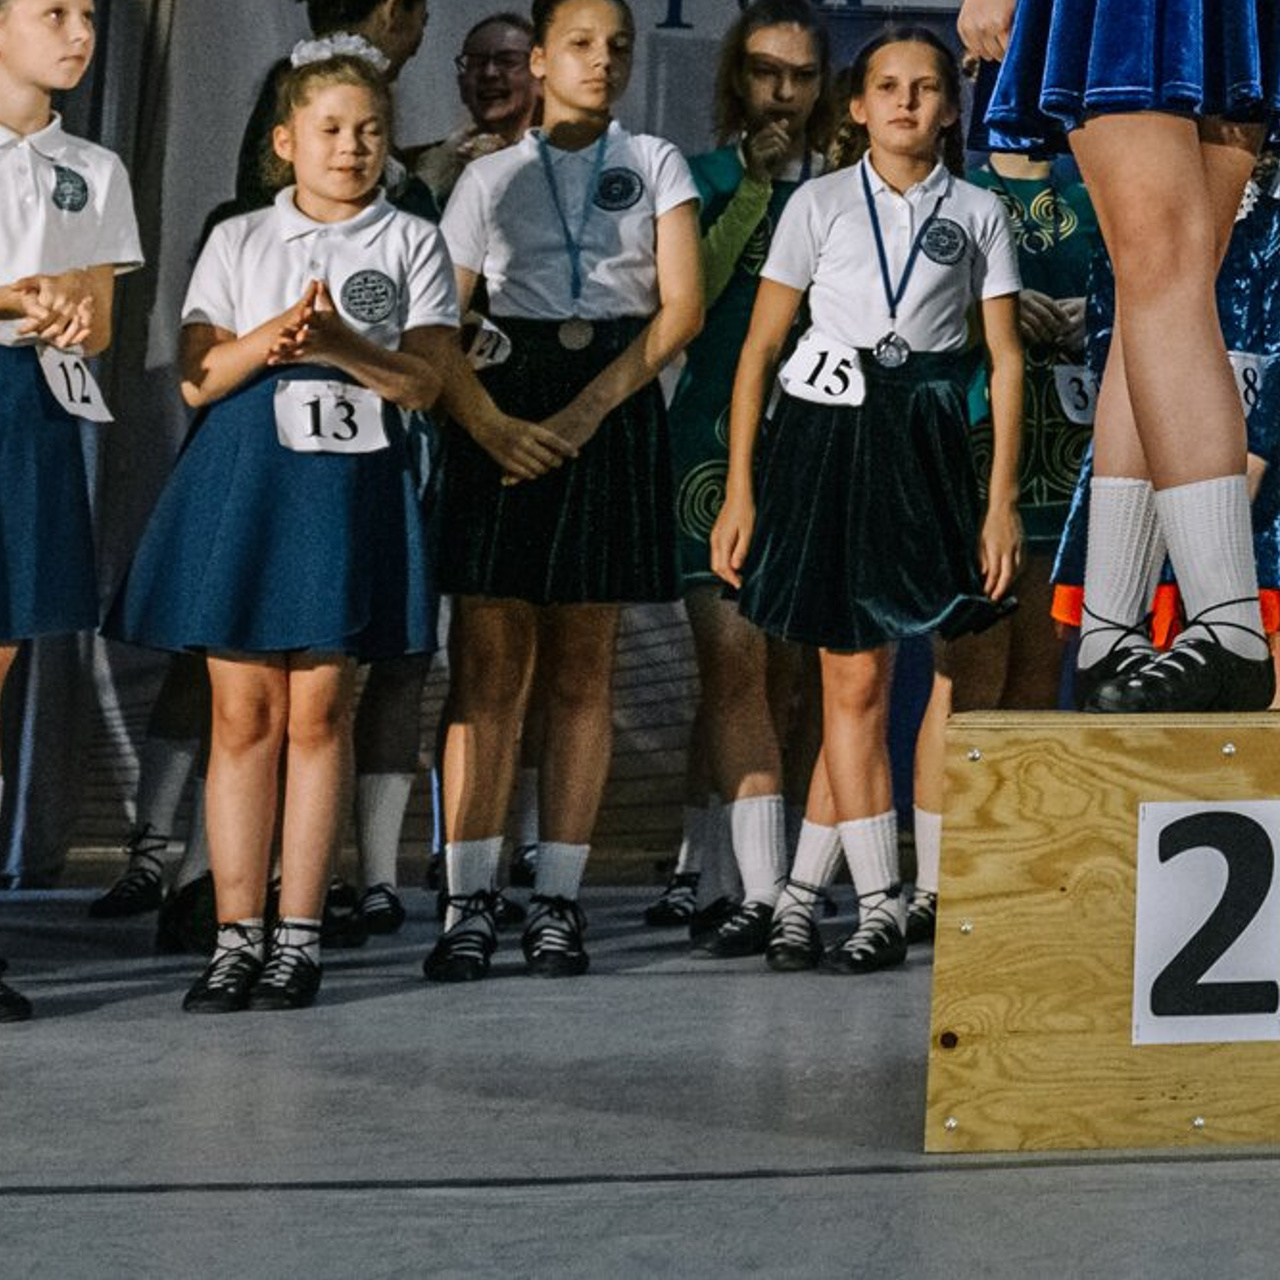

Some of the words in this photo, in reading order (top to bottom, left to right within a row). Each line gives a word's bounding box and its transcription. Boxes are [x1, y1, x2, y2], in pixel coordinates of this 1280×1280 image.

[58, 361, 92, 405] 12
[803, 350, 853, 396] 15
[302, 399, 359, 441] 13
[1150, 811, 1280, 1017] 2
